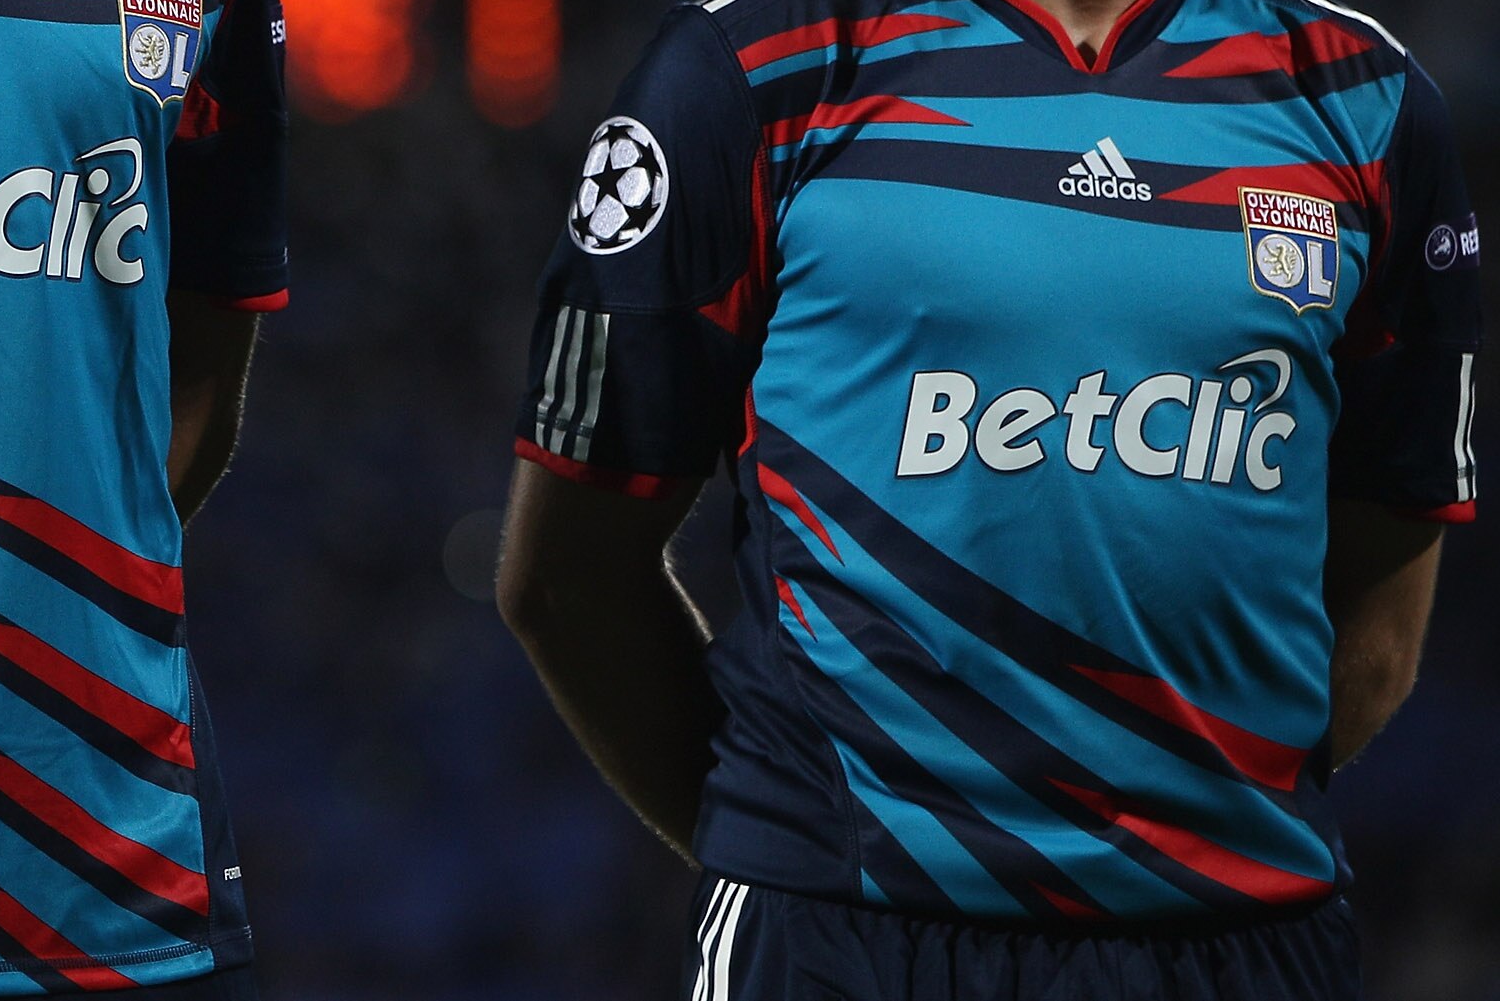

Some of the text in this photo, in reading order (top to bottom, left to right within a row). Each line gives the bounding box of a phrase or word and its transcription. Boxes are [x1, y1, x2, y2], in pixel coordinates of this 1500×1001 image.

[1057, 173, 1153, 202] adidas
[1247, 192, 1331, 221] OLYMPIQUE
[1249, 208, 1334, 236] LYONNAIS
[896, 369, 1297, 491] BetClic
